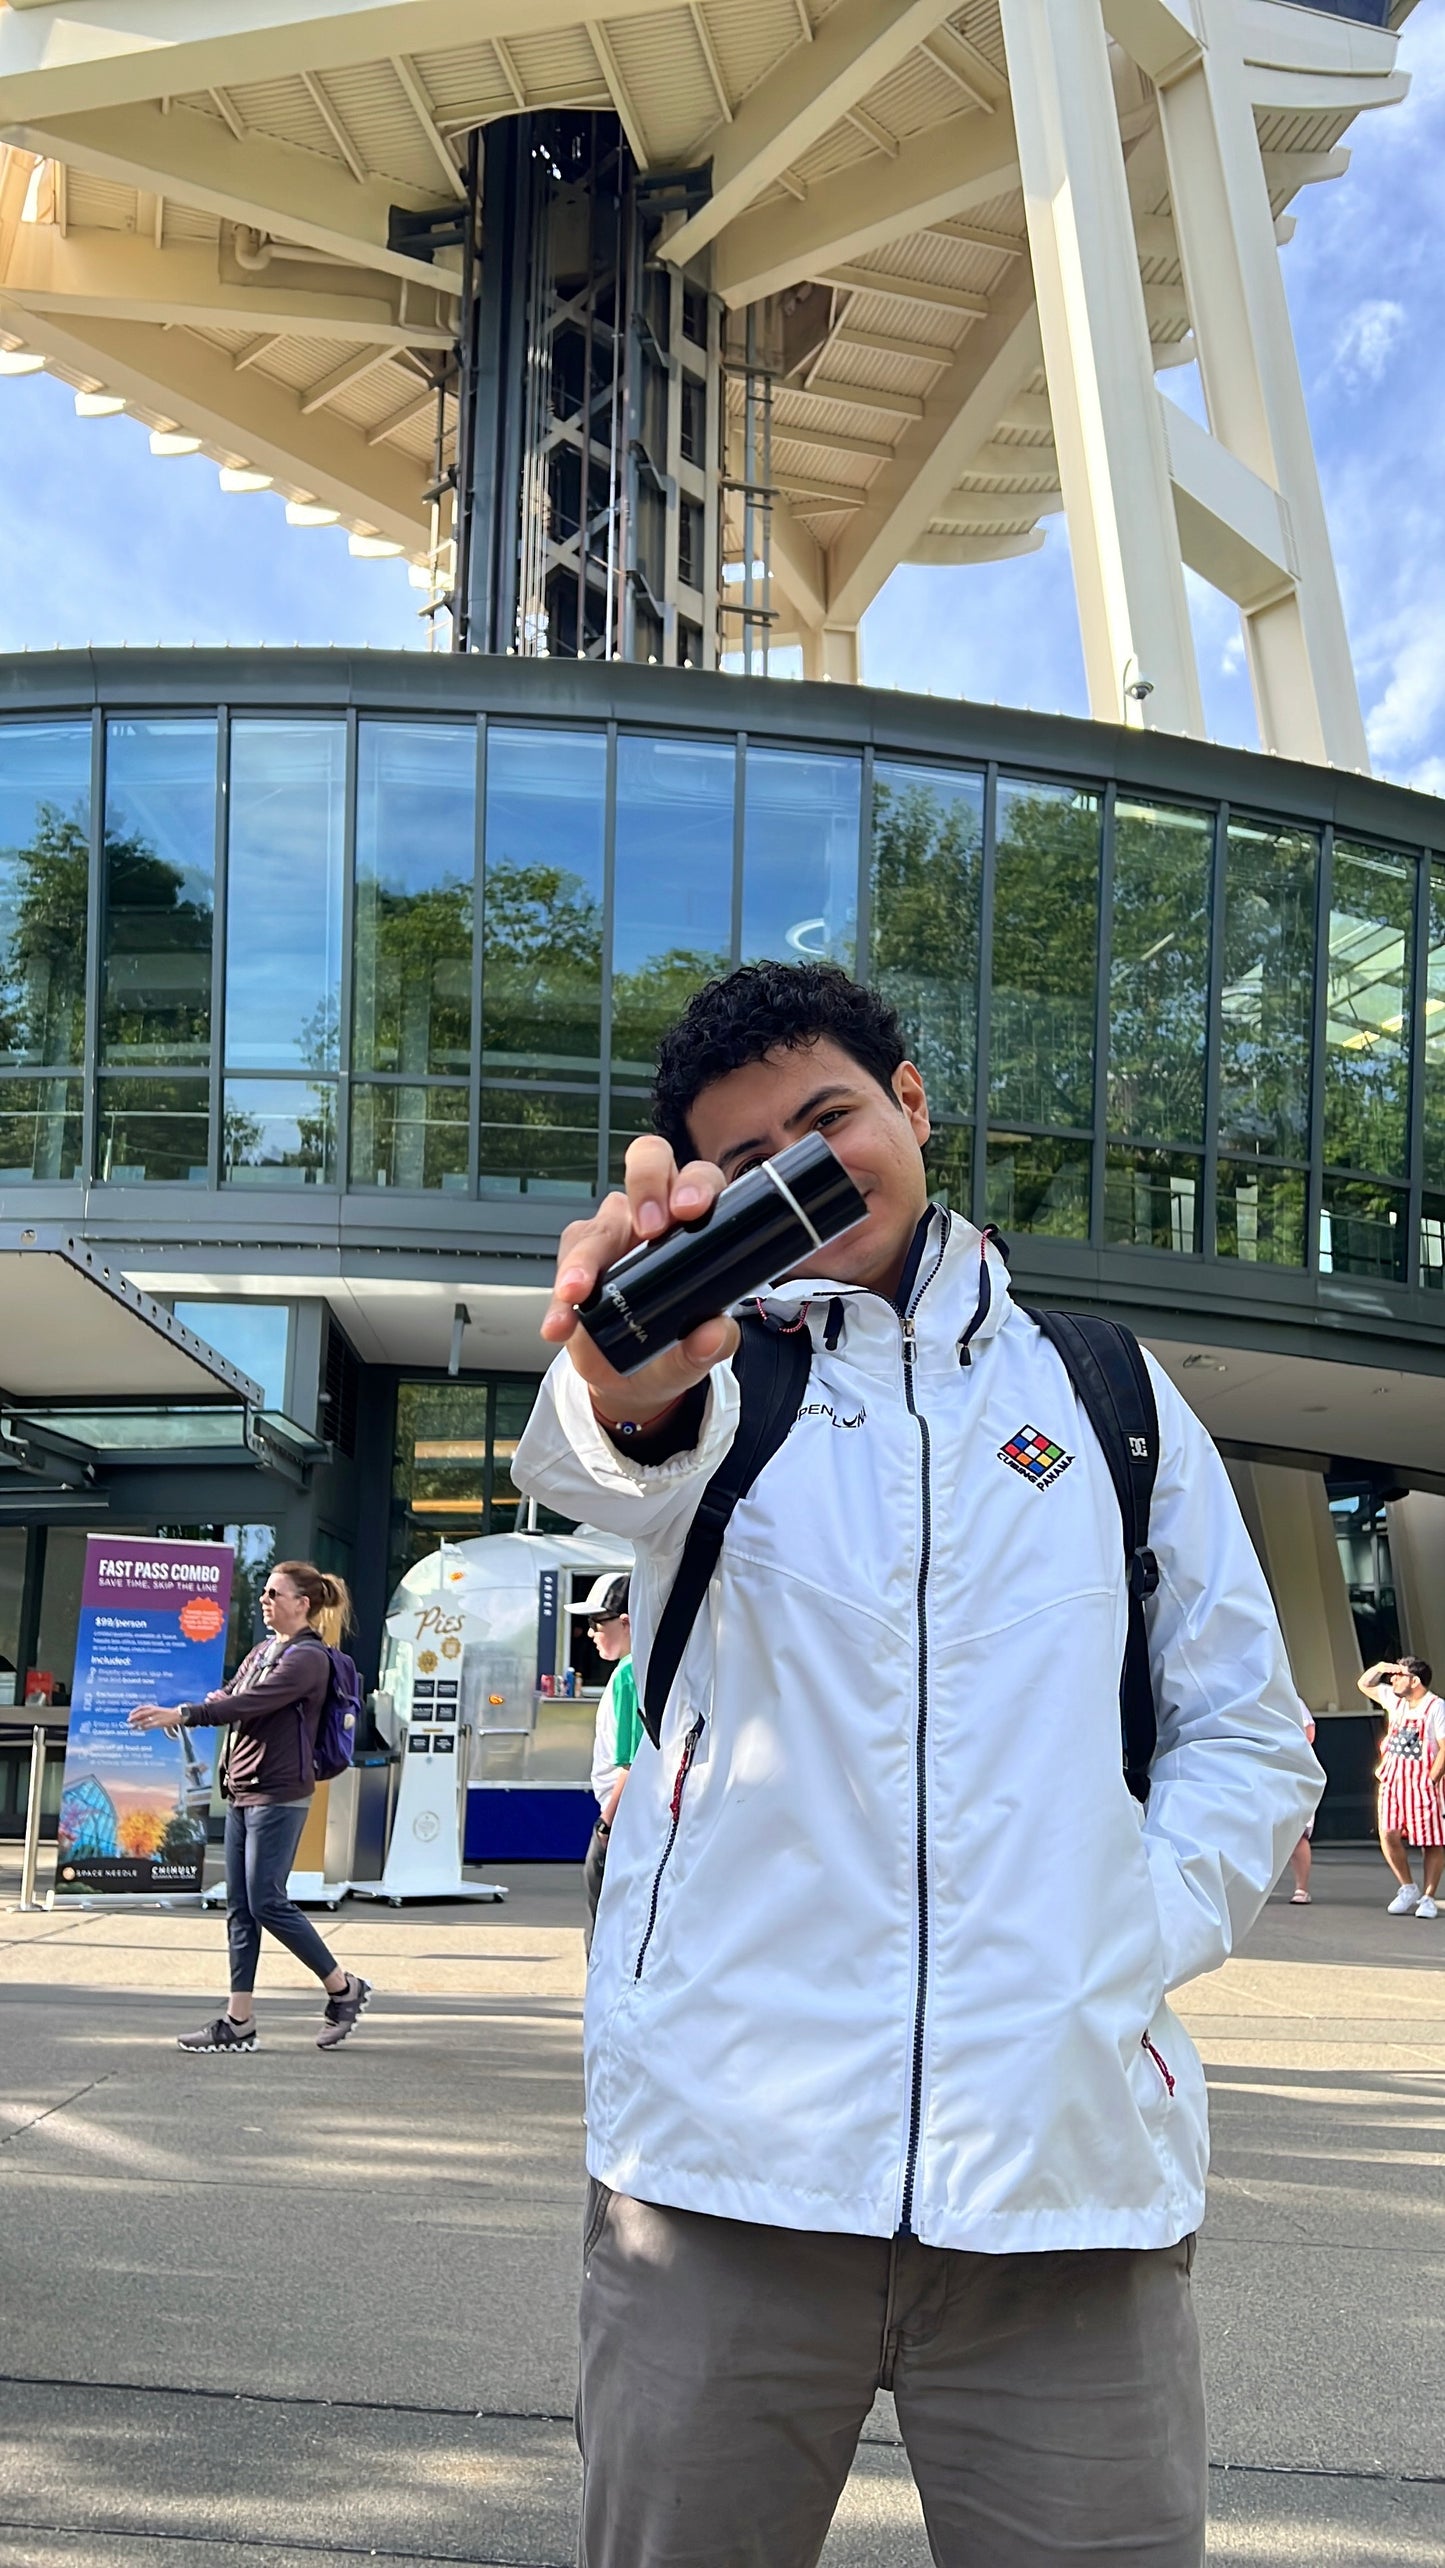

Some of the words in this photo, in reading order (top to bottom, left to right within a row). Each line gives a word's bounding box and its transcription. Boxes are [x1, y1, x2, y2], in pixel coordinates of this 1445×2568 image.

[605, 1283, 629, 1313] OPEN
[623, 1311, 649, 1343] LUNA
[794, 1404, 833, 1423] PEN
[996, 1452, 1038, 1484] CUBING
[1036, 1455, 1076, 1492] PANAMA
[98, 1560, 134, 1577] FAST
[134, 1561, 170, 1580] PASS
[170, 1563, 220, 1583] COMBO
[98, 1577, 123, 1588] SAVE
[152, 1580, 174, 1590] SKIP
[177, 1581, 194, 1591] THE
[196, 1582, 218, 1593] LINE
[543, 1576, 553, 1616] ORDER
[76, 1869, 102, 1878] SPACE
[104, 1869, 138, 1878] NEEDLE
